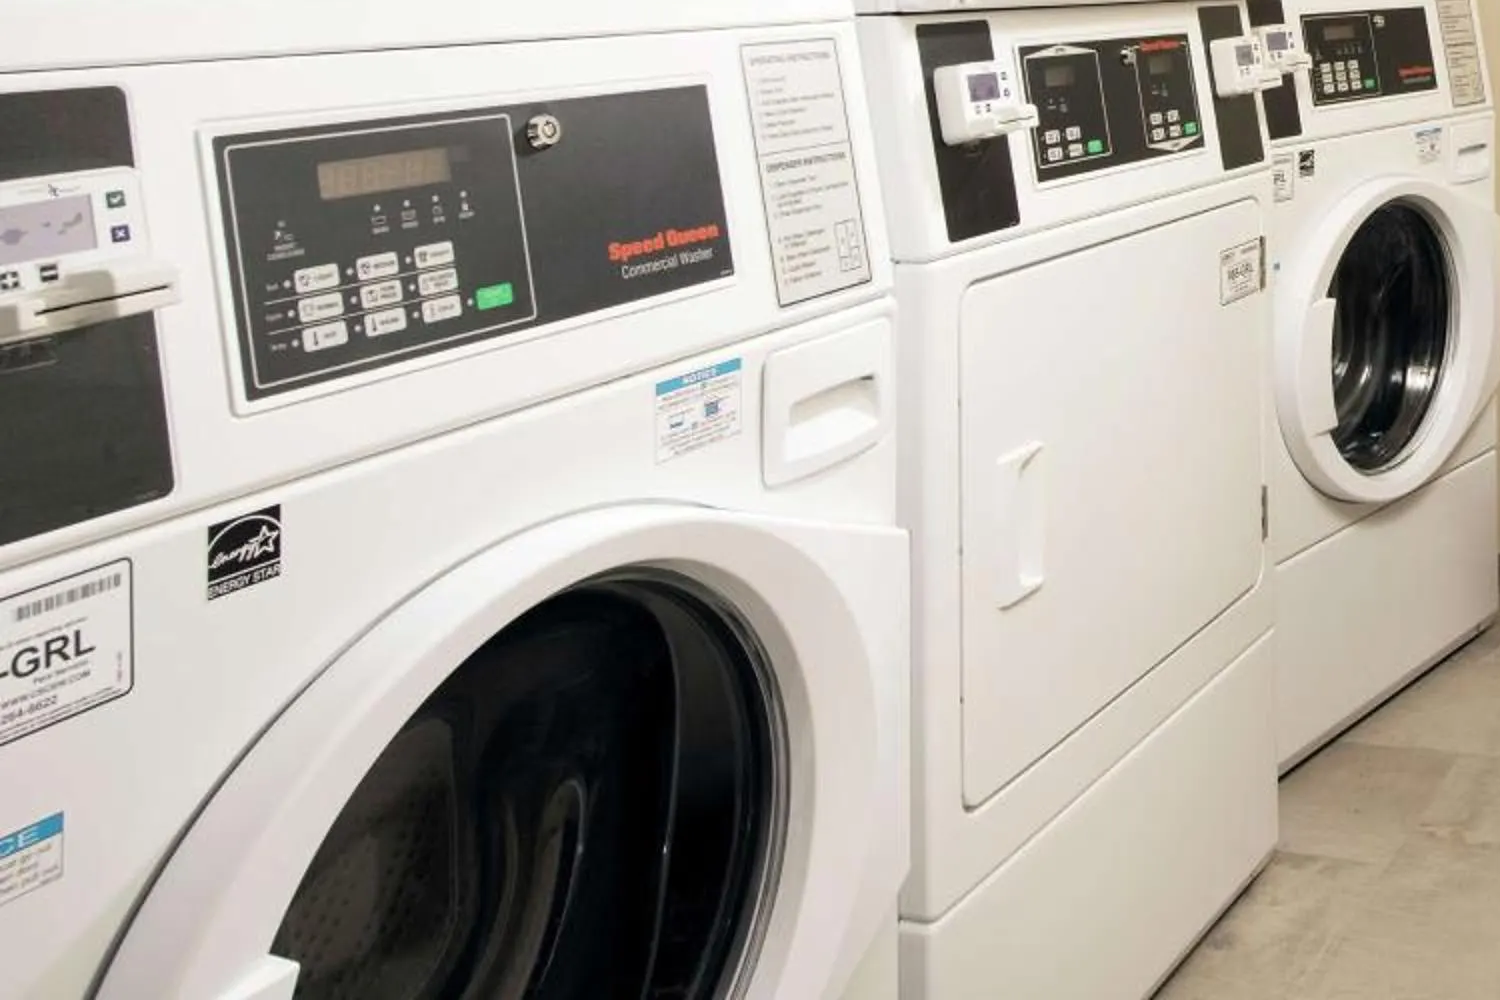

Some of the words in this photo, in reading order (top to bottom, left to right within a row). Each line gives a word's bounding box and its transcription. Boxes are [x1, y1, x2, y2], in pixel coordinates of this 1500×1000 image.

[608, 231, 665, 262] Speed
[665, 224, 719, 247] Queen
[621, 253, 679, 278] Commercial
[679, 247, 713, 265] Washer
[208, 573, 252, 599] ENERGY
[252, 563, 281, 582] STAR
